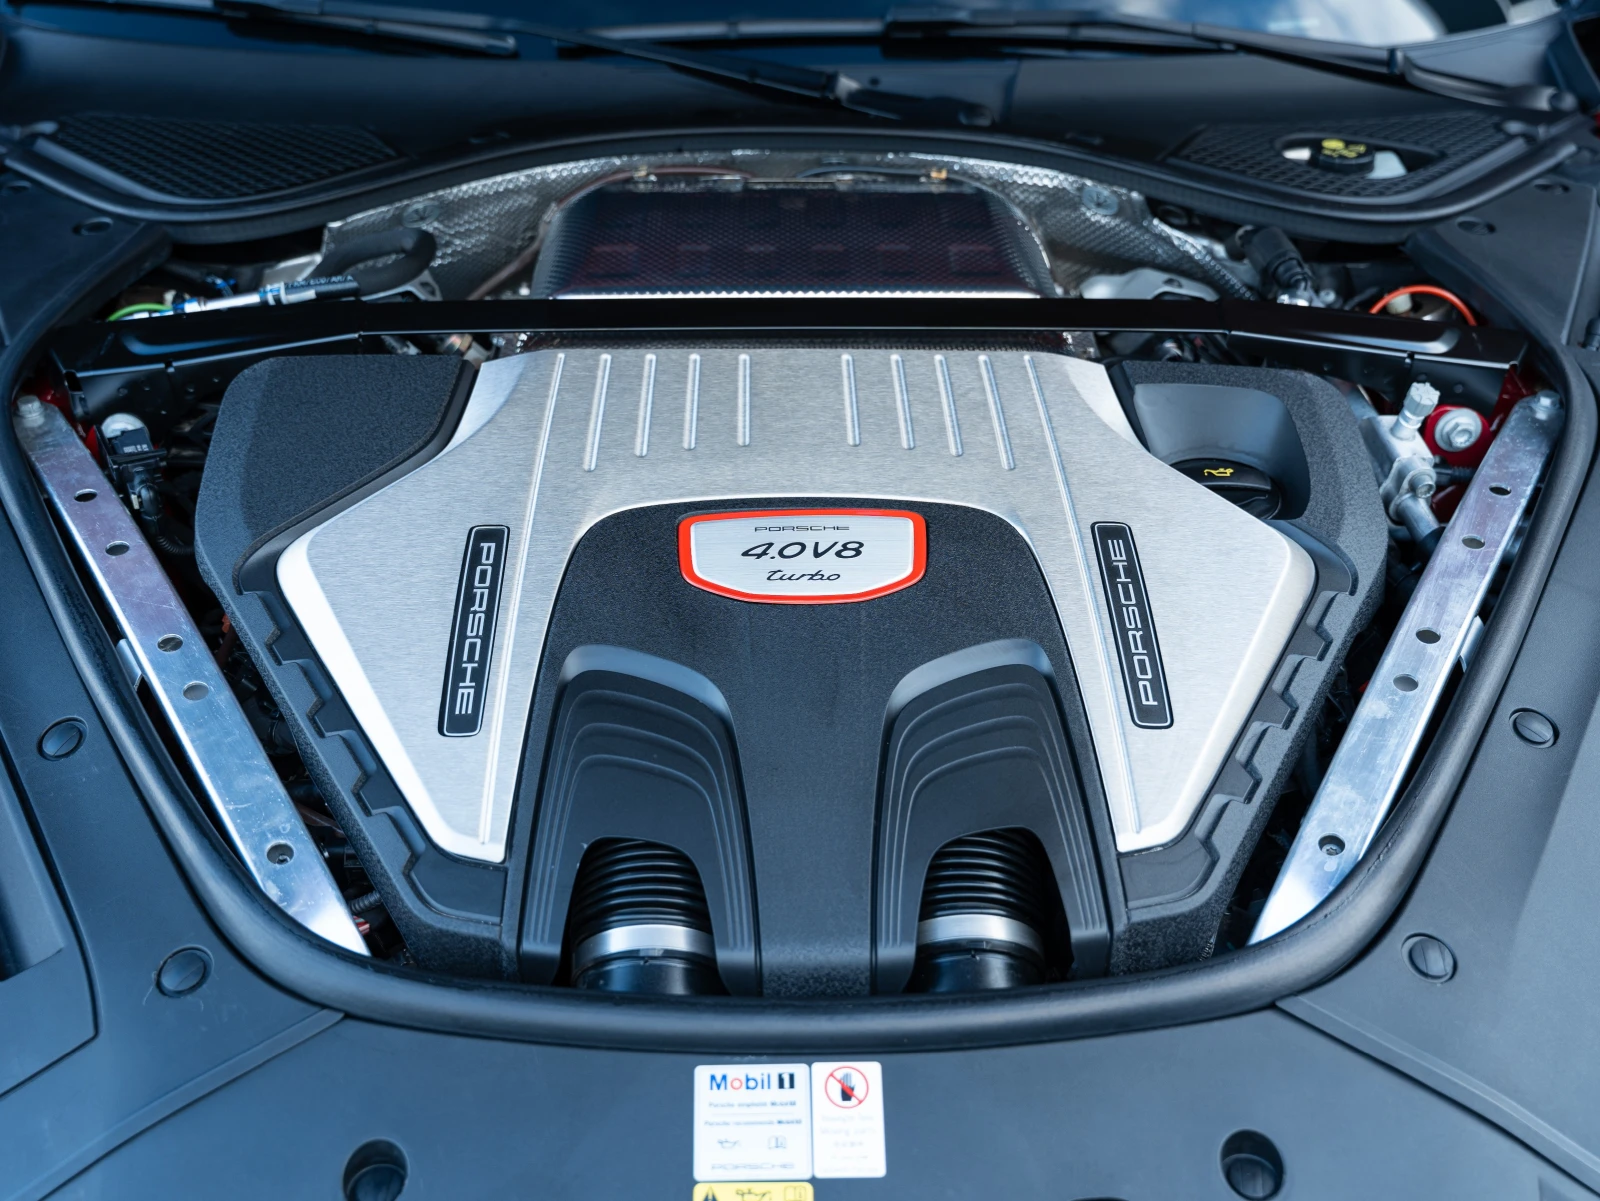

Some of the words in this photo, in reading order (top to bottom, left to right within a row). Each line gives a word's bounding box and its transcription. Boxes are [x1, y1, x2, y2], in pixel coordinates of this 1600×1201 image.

[766, 569, 841, 581] turbo
[455, 542, 496, 715] PORSCHE
[1107, 539, 1159, 706] PORSCHE
[709, 1073, 771, 1091] Mobil
